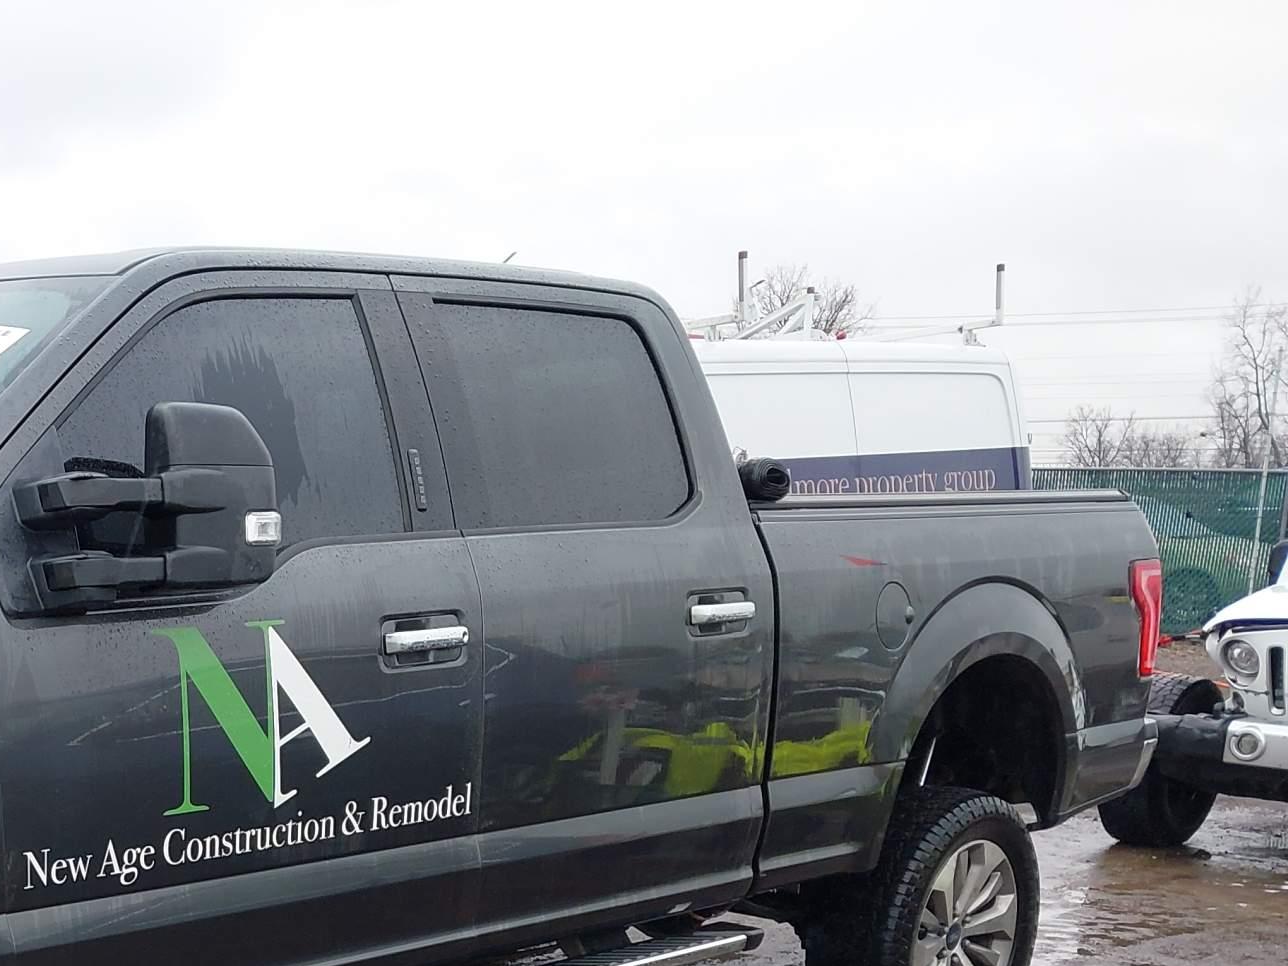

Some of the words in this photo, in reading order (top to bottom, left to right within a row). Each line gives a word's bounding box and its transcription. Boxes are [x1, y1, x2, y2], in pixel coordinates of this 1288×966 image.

[854, 469, 937, 493] property
[944, 470, 995, 492] group
[23, 848, 93, 890] New
[97, 839, 155, 886] Age
[163, 810, 335, 867] Construction
[341, 800, 366, 836] &
[370, 782, 472, 832] Remodel
